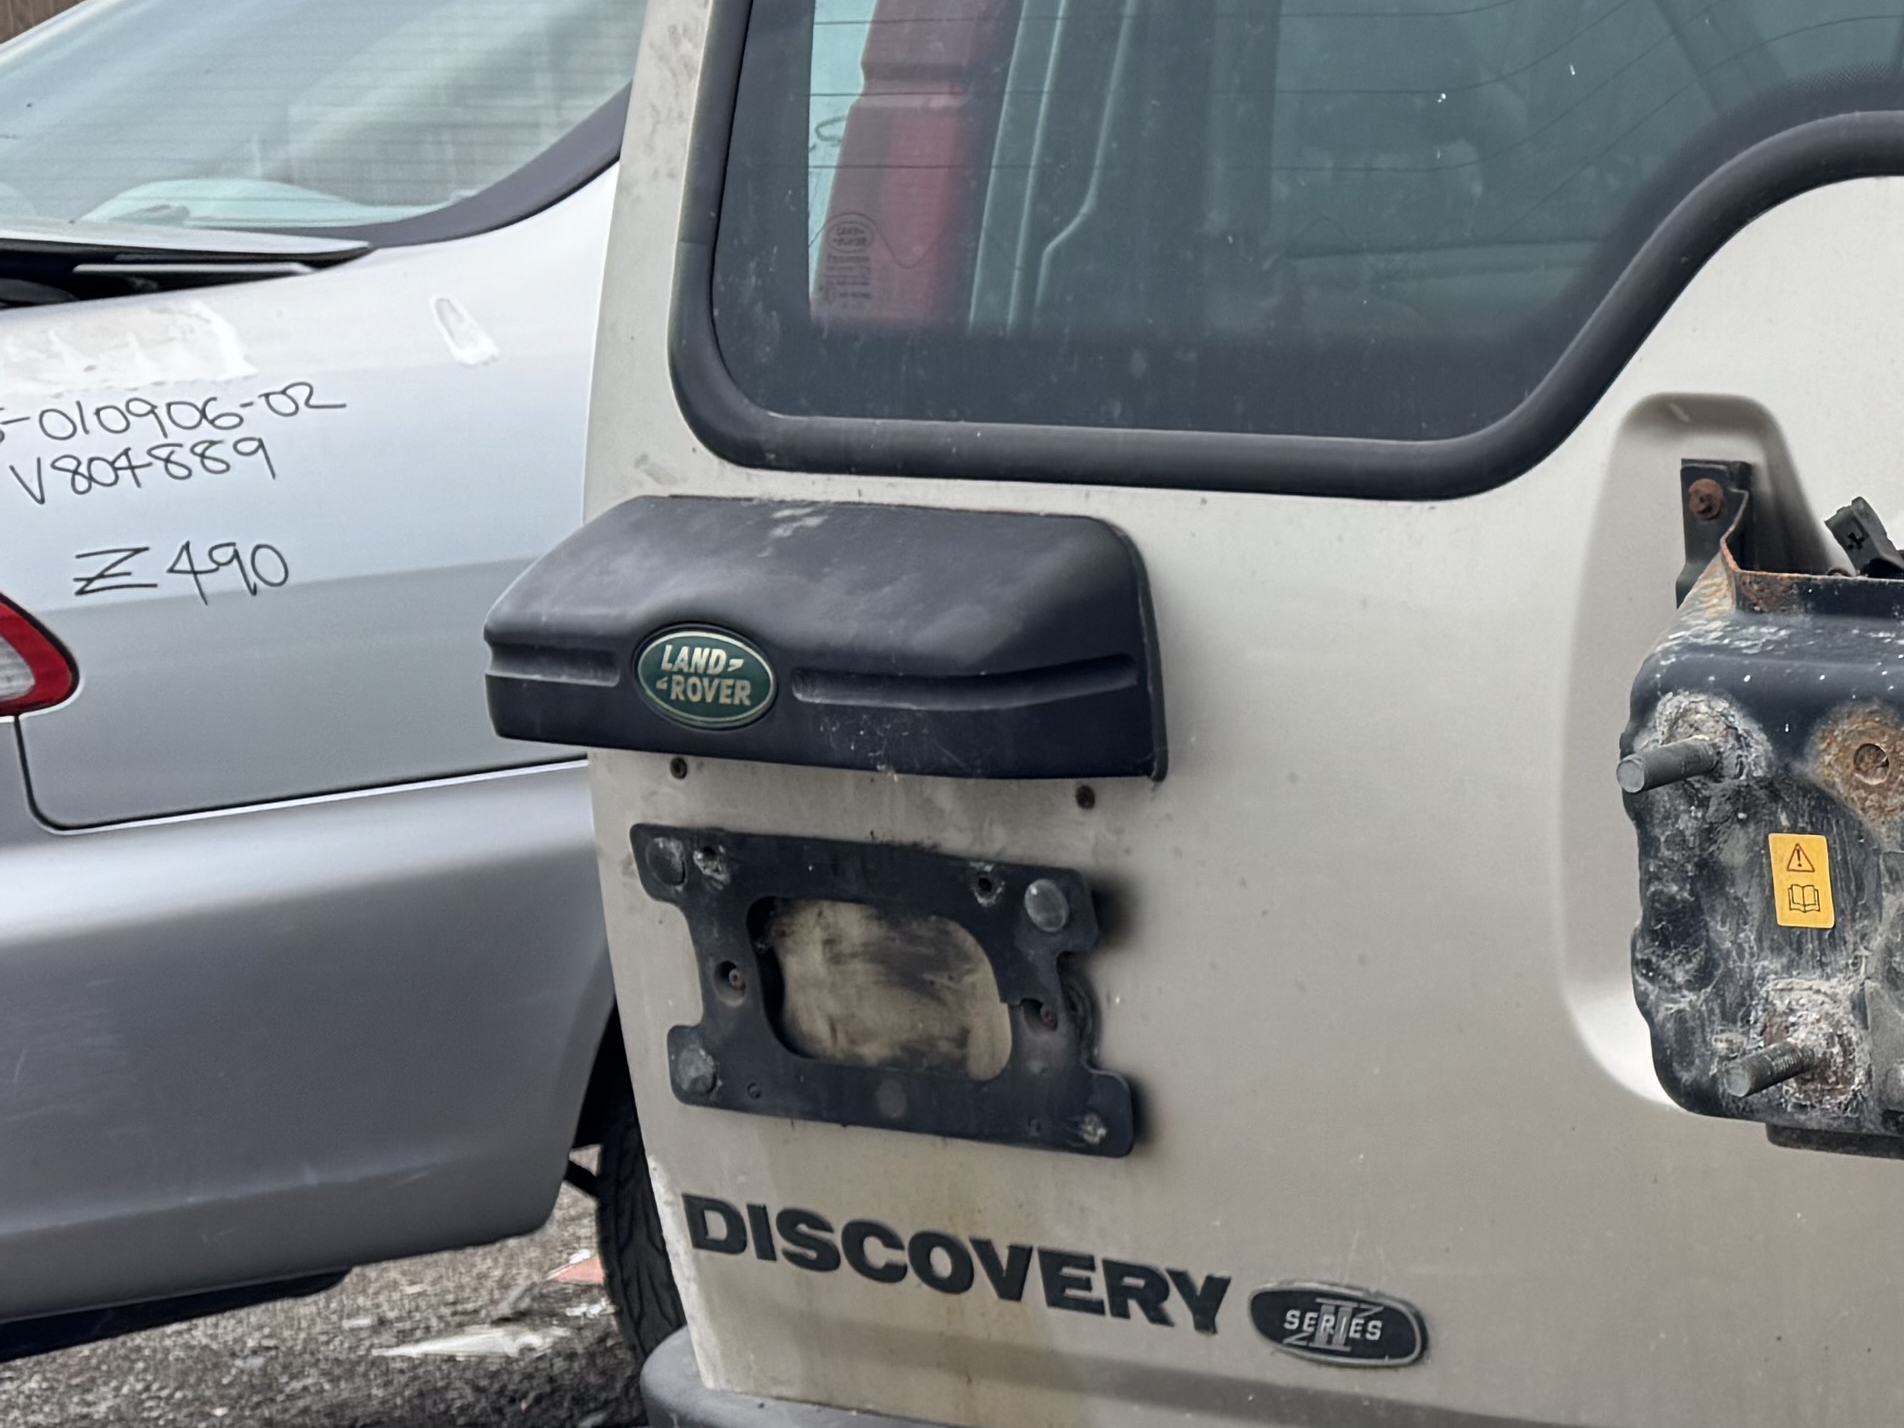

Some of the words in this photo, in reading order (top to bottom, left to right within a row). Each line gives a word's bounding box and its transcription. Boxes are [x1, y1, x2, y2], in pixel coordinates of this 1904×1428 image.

[0, 381, 347, 444] -010906-02
[9, 436, 277, 505] V804889
[661, 644, 727, 675] LAND
[670, 674, 751, 706] ROVER
[681, 1192, 1232, 1336] DISCOVERY
[1283, 1309, 1384, 1341] SERIES
